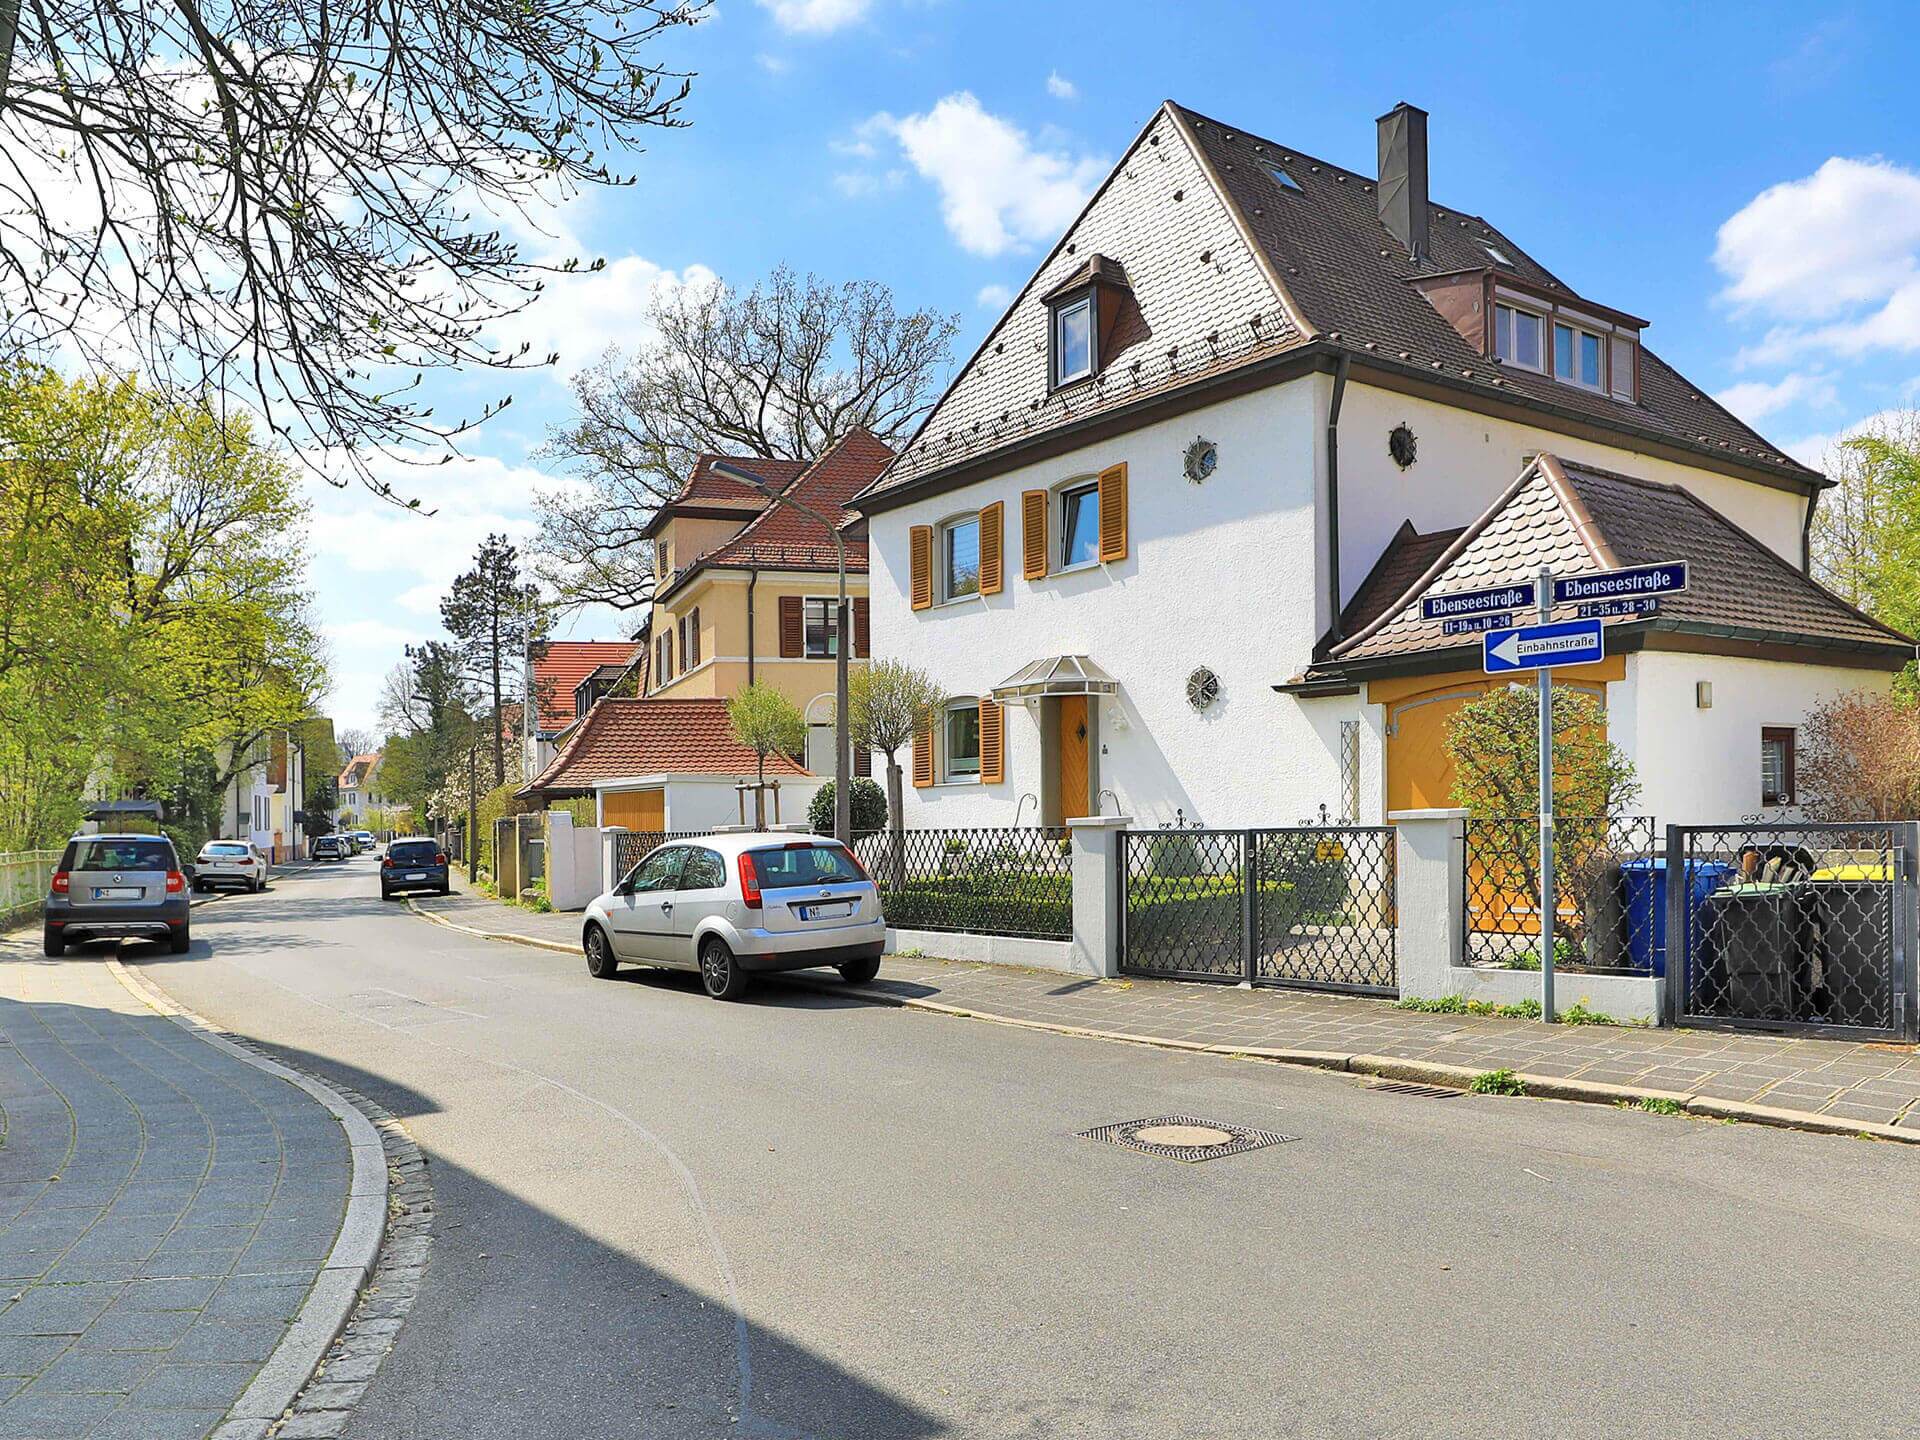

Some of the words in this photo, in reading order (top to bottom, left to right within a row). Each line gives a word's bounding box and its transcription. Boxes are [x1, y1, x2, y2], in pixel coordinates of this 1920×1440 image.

[1565, 571, 1671, 597] Ebenseestraße
[1432, 589, 1523, 614] Ebenseestraße
[1581, 603, 1610, 617] 21-35
[1612, 605, 1621, 615] u.
[1622, 599, 1656, 614] 28-30
[1483, 616, 1511, 629] 10-26
[1517, 636, 1595, 654] Einbahnstraße
